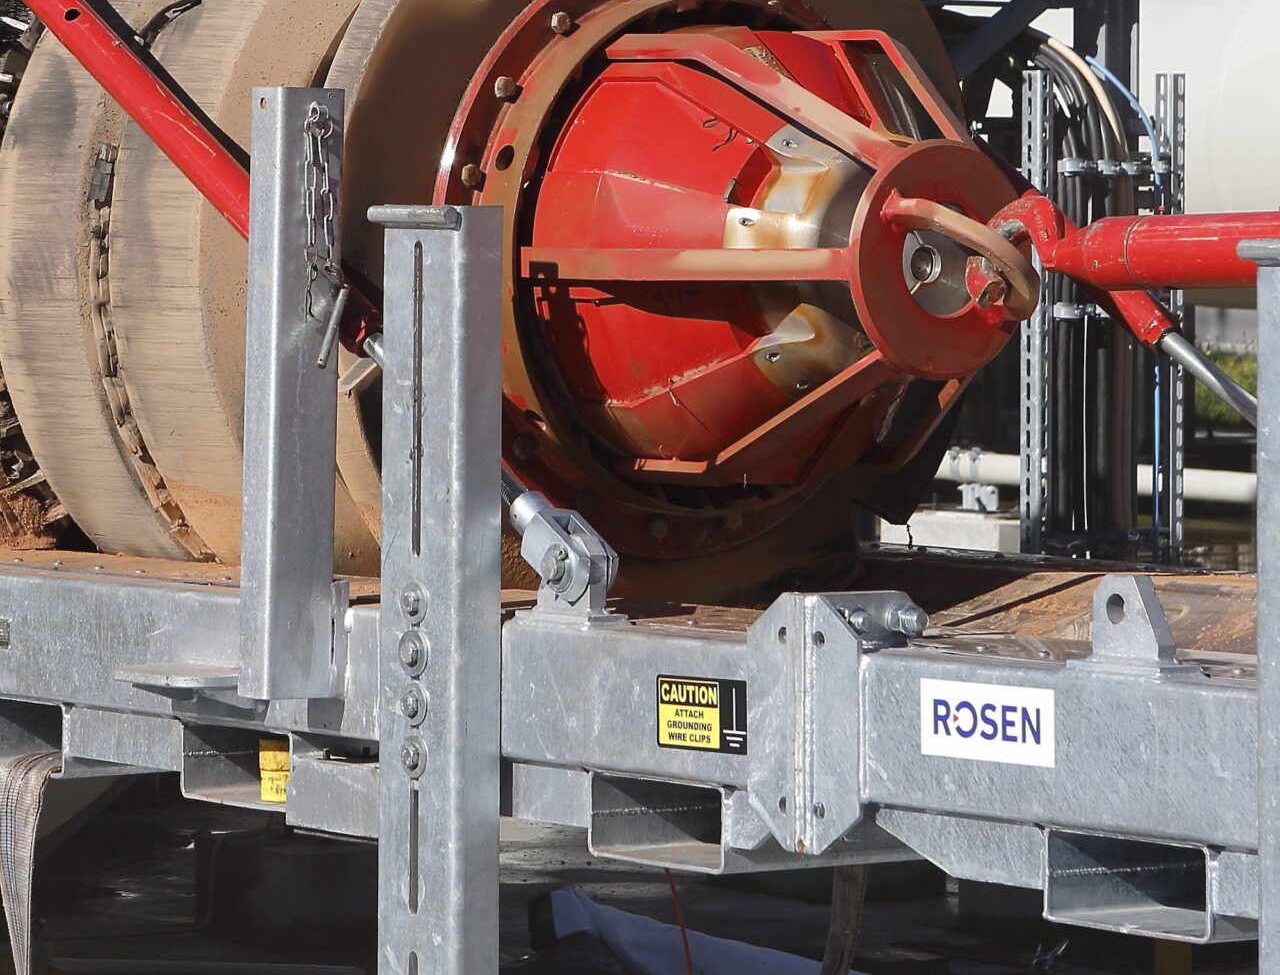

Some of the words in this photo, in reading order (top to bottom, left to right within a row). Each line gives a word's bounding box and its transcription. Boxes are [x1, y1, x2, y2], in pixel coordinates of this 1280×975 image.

[661, 682, 717, 705] CAUTION
[675, 708, 704, 719] ATTACH
[667, 719, 712, 731] GROUNDING
[933, 698, 1041, 745] ROSEN
[668, 731, 687, 742] WIRE
[689, 734, 711, 744] CLIPS
